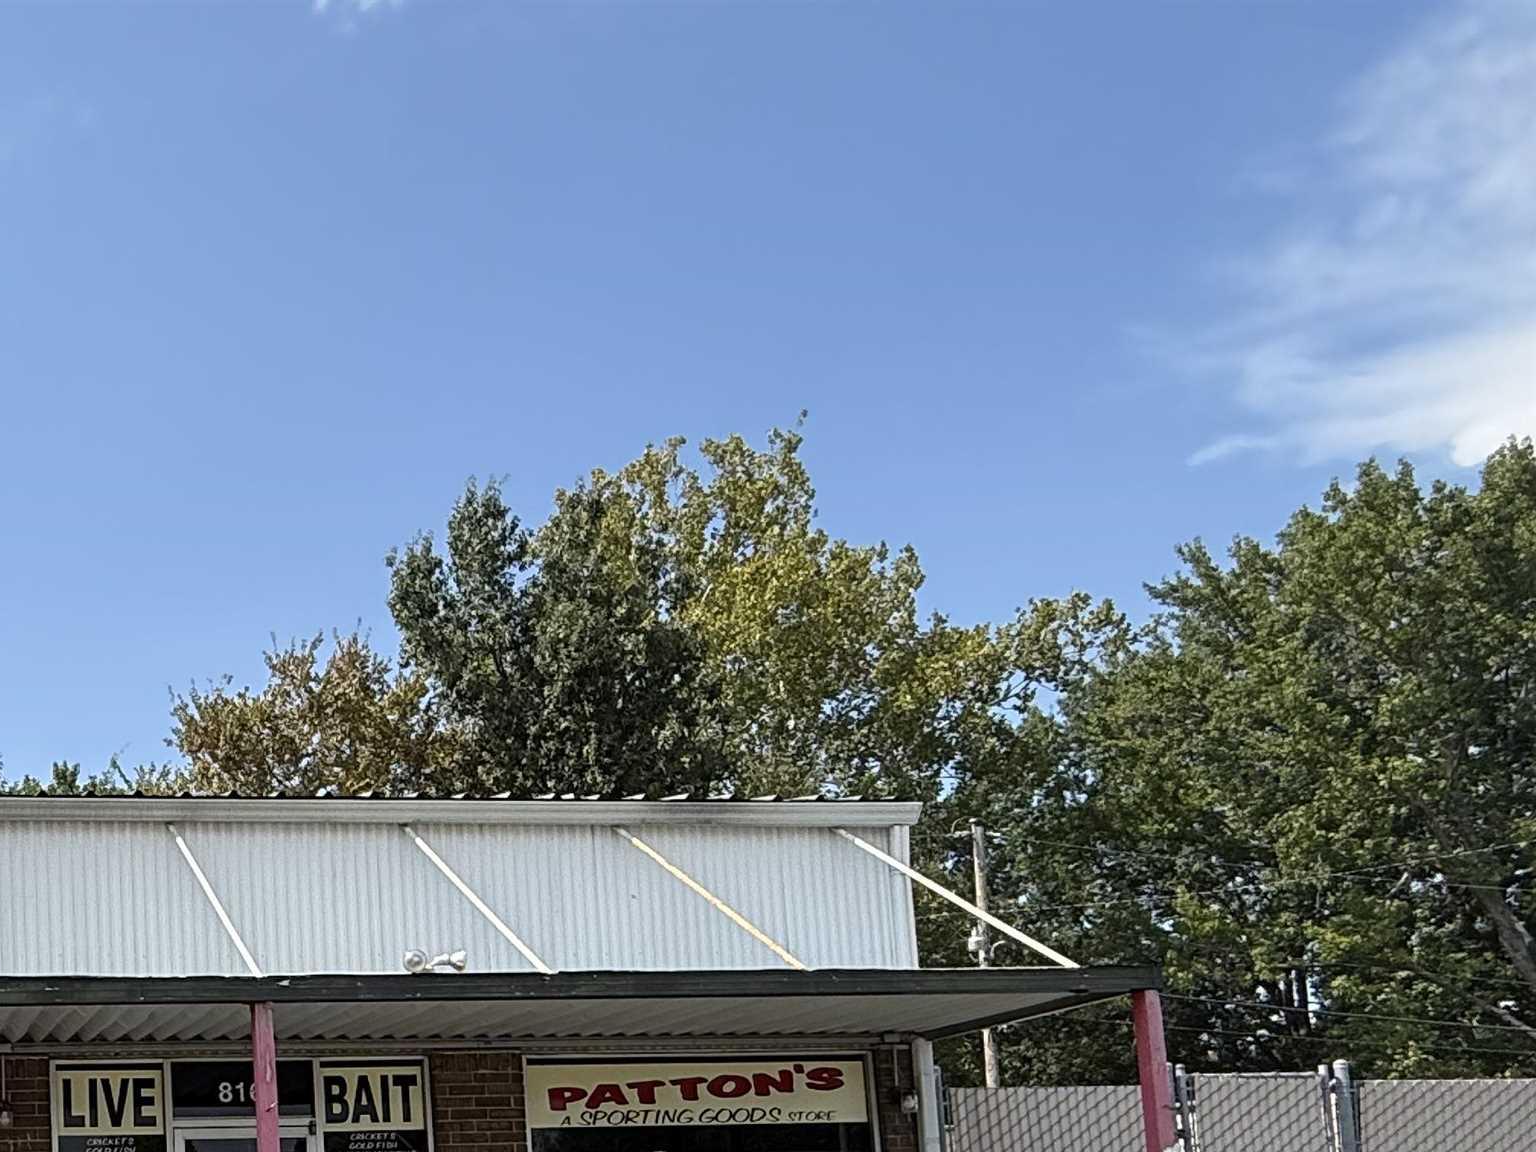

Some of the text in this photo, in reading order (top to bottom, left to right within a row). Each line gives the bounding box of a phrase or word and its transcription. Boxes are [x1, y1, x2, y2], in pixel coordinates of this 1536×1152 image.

[62, 1078, 157, 1127] LIVE
[323, 1074, 418, 1124] BAIT
[546, 1063, 845, 1112] PATTON'S
[559, 1106, 838, 1126] A SPORTING GOODS STORE
